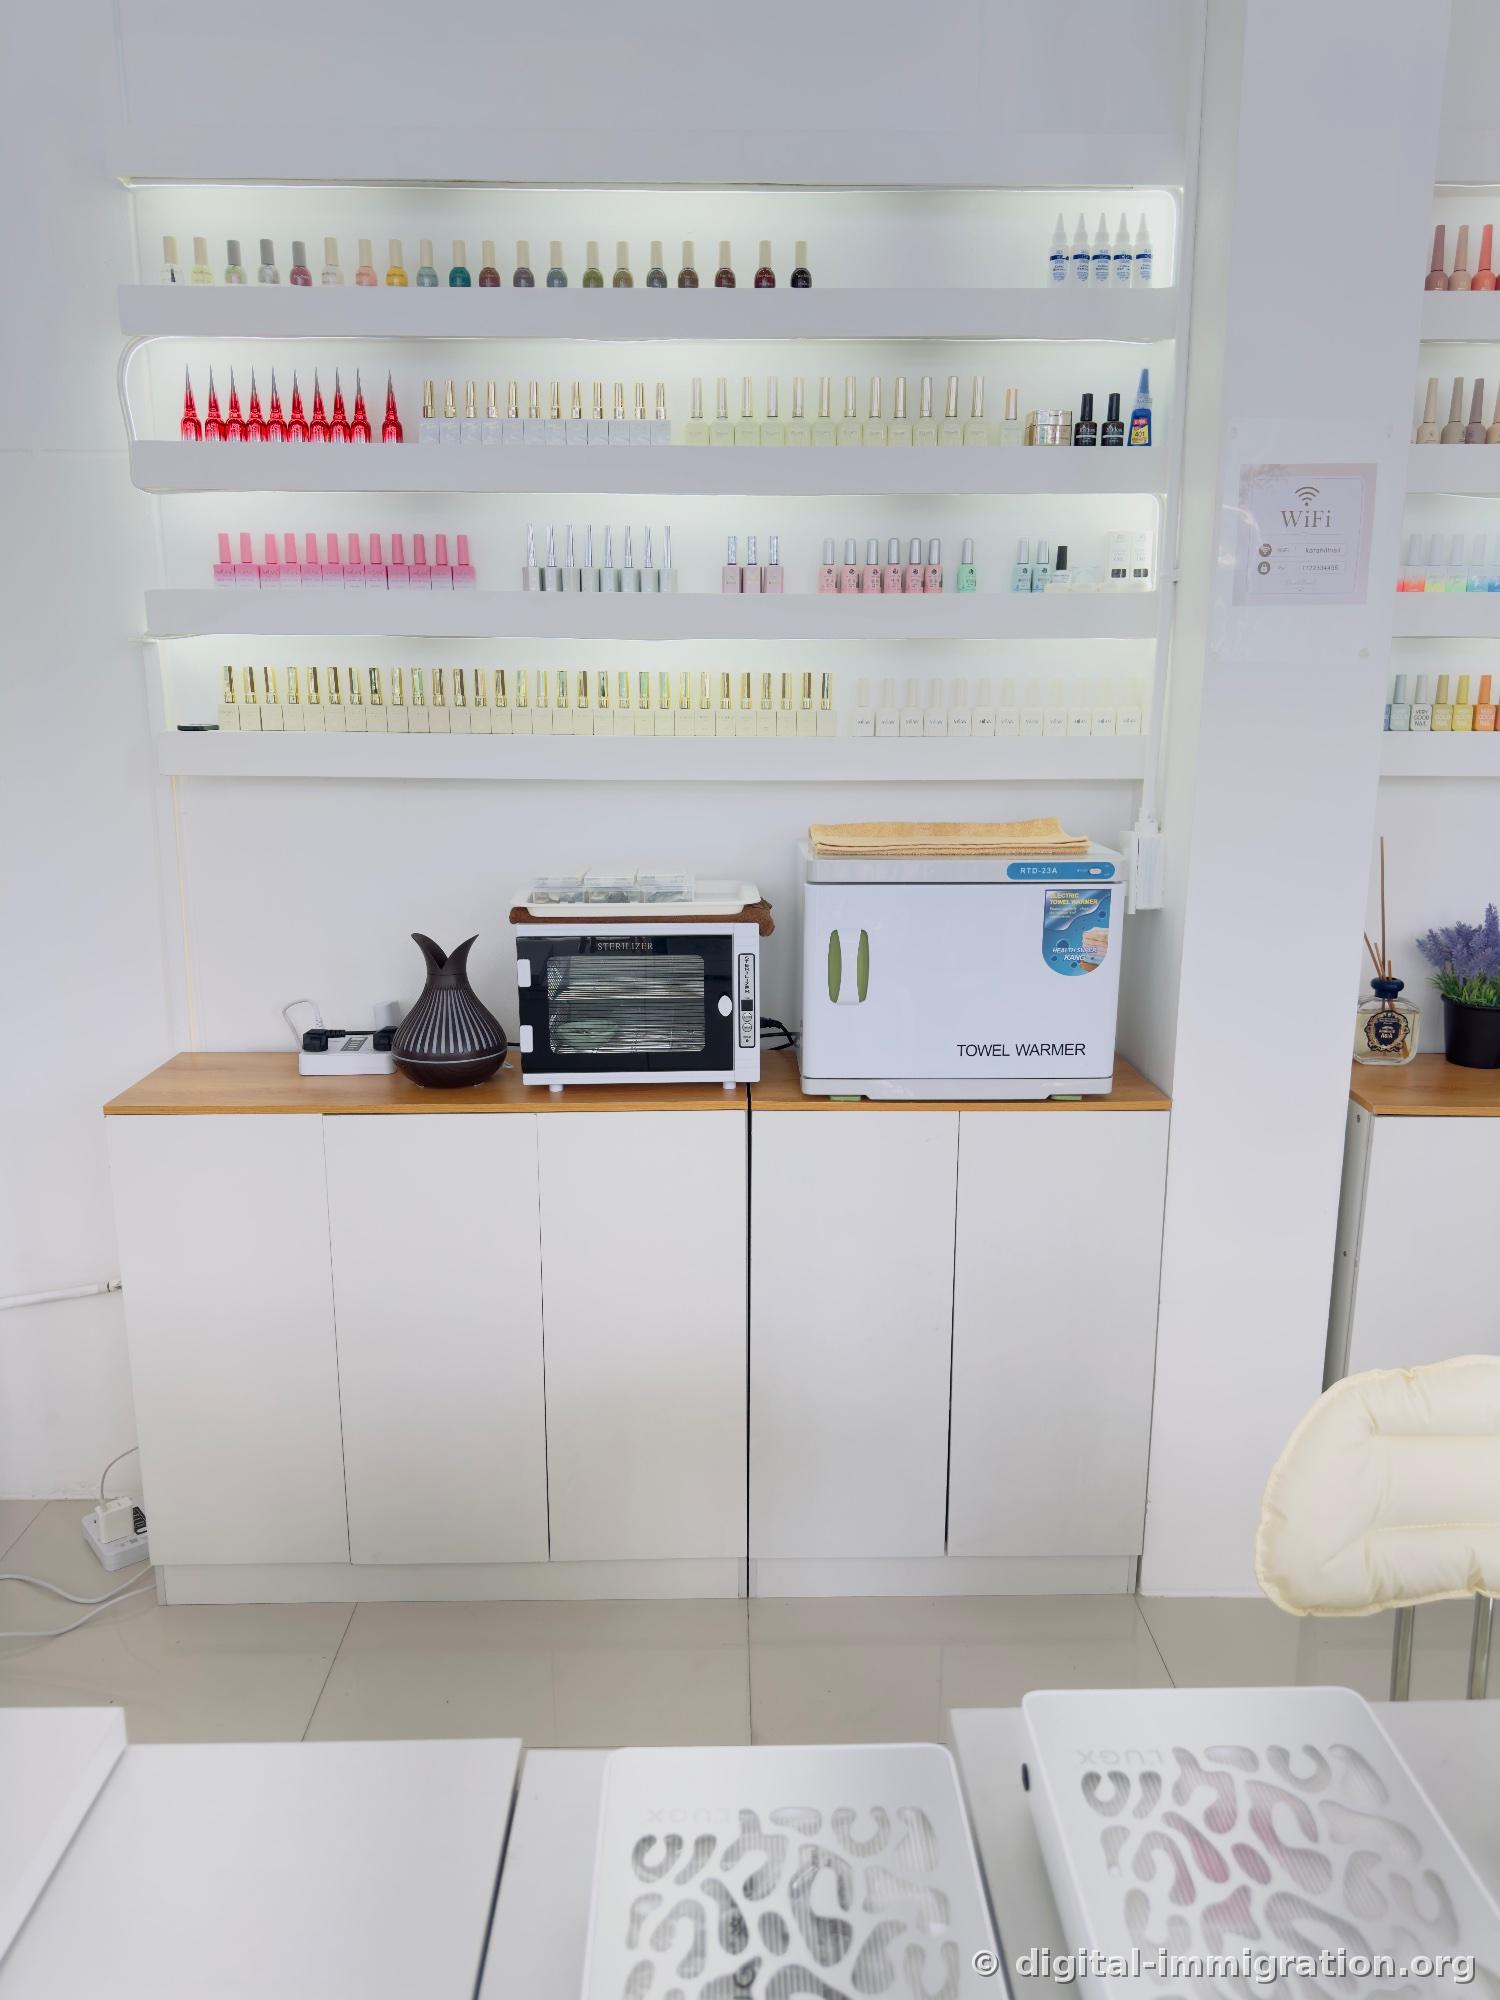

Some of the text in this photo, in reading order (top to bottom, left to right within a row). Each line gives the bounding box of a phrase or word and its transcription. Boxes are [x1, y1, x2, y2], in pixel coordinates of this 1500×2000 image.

[1280, 510, 1331, 528] WiFi
[597, 942, 653, 951] STERILIZER
[956, 1043, 1086, 1057] TOWEL WARMER
